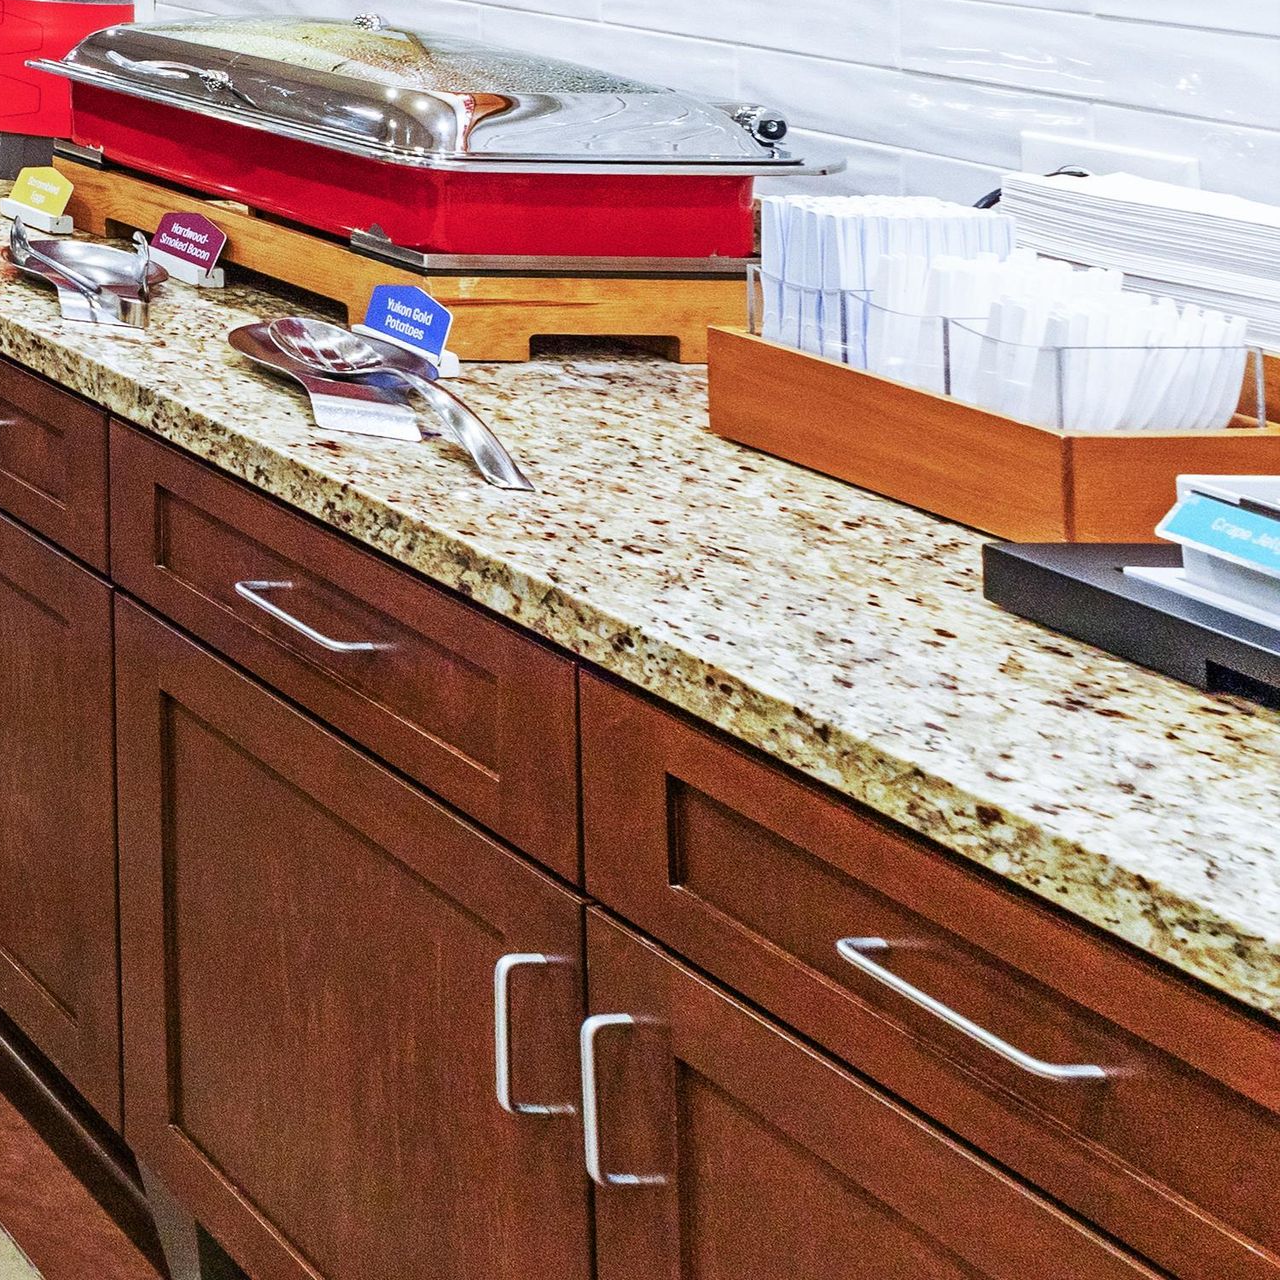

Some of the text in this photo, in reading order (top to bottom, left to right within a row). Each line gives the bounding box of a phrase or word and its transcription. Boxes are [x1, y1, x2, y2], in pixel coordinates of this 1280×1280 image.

[159, 232, 210, 261] Smoked Bacon
[171, 222, 209, 245] Hardwood-
[386, 297, 434, 326] Yukon Gold
[384, 314, 425, 340] Potatoes
